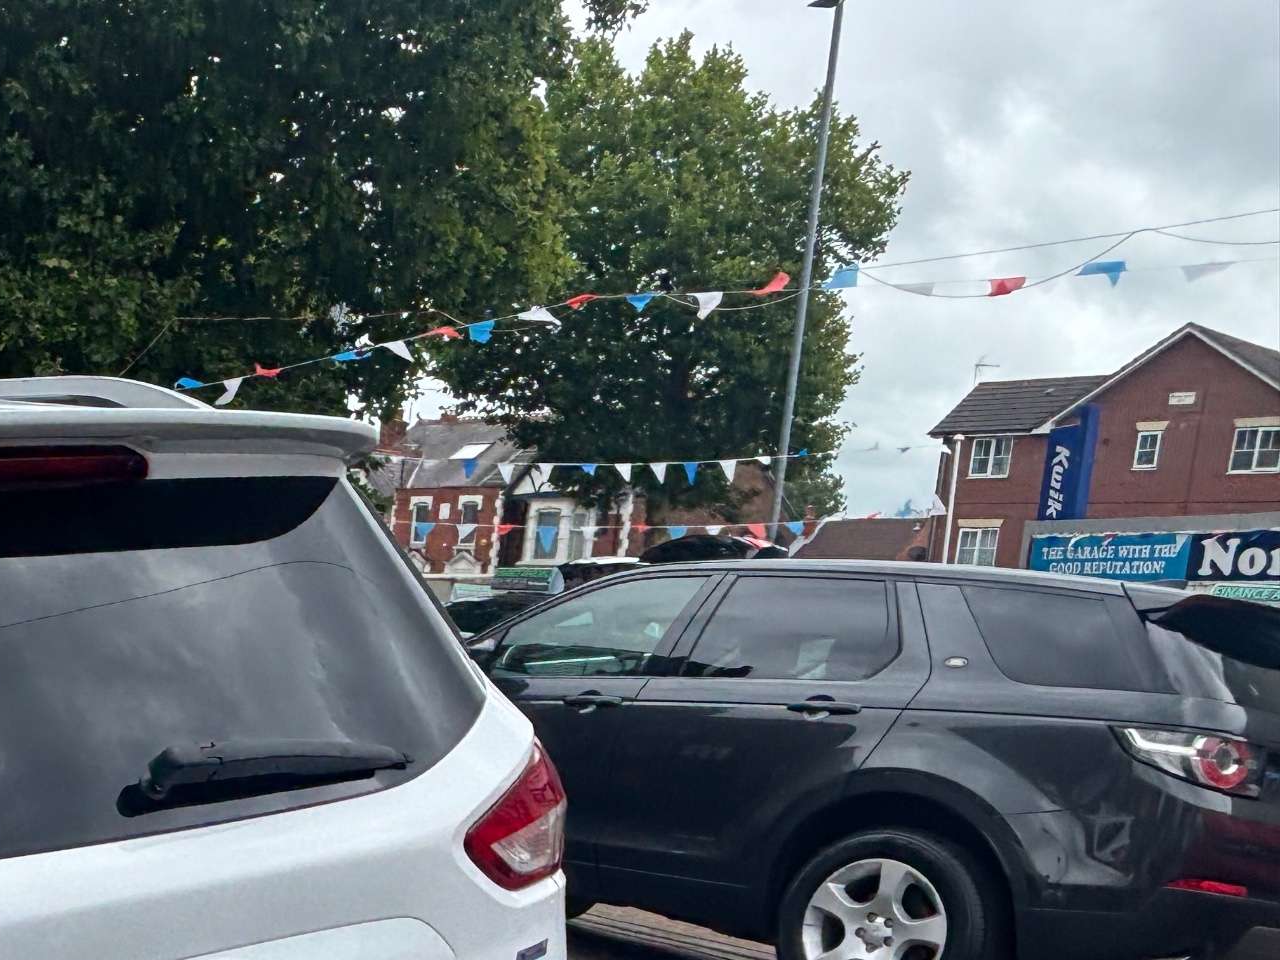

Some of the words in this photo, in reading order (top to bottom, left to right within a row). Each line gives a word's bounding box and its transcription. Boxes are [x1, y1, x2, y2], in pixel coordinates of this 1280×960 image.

[1045, 445, 1071, 519] Kwik
[1042, 546, 1065, 560] THE
[1066, 544, 1115, 560] GARAGE
[1118, 544, 1150, 559] WITH
[1153, 543, 1179, 558] THE
[1049, 561, 1081, 576] GOOD
[1082, 559, 1166, 575] REPUTATION!
